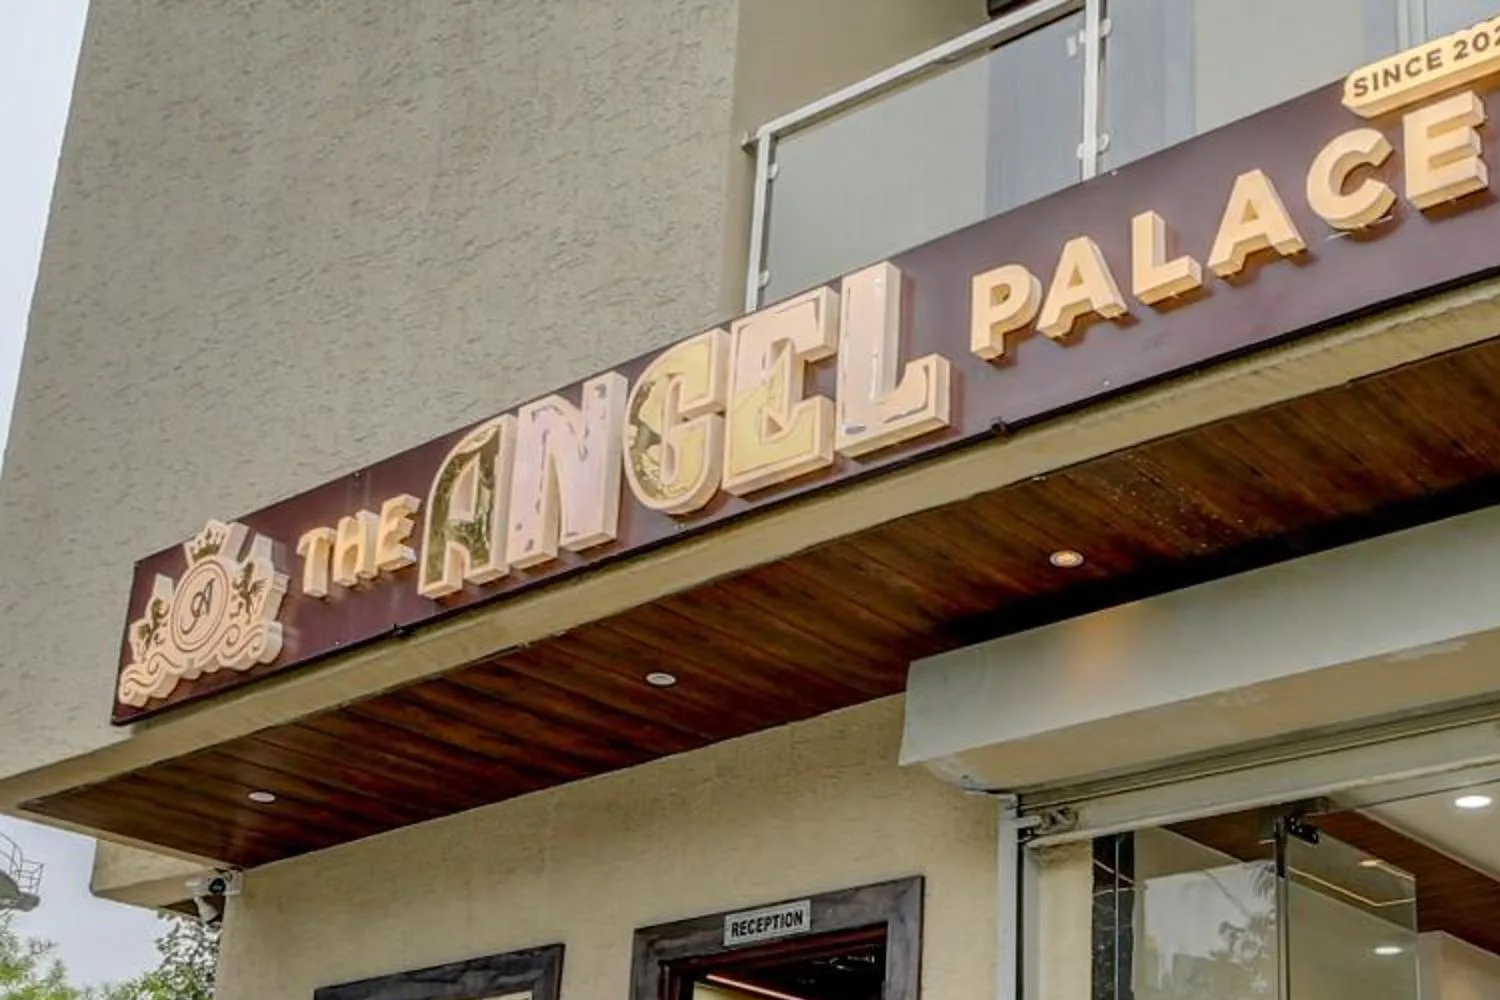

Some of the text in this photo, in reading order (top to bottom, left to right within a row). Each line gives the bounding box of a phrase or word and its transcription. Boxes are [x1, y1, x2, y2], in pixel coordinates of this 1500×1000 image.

[1352, 48, 1444, 98] SINCE
[296, 89, 1490, 600] THE ANGEL PALACE
[731, 909, 804, 937] RECEPTION
